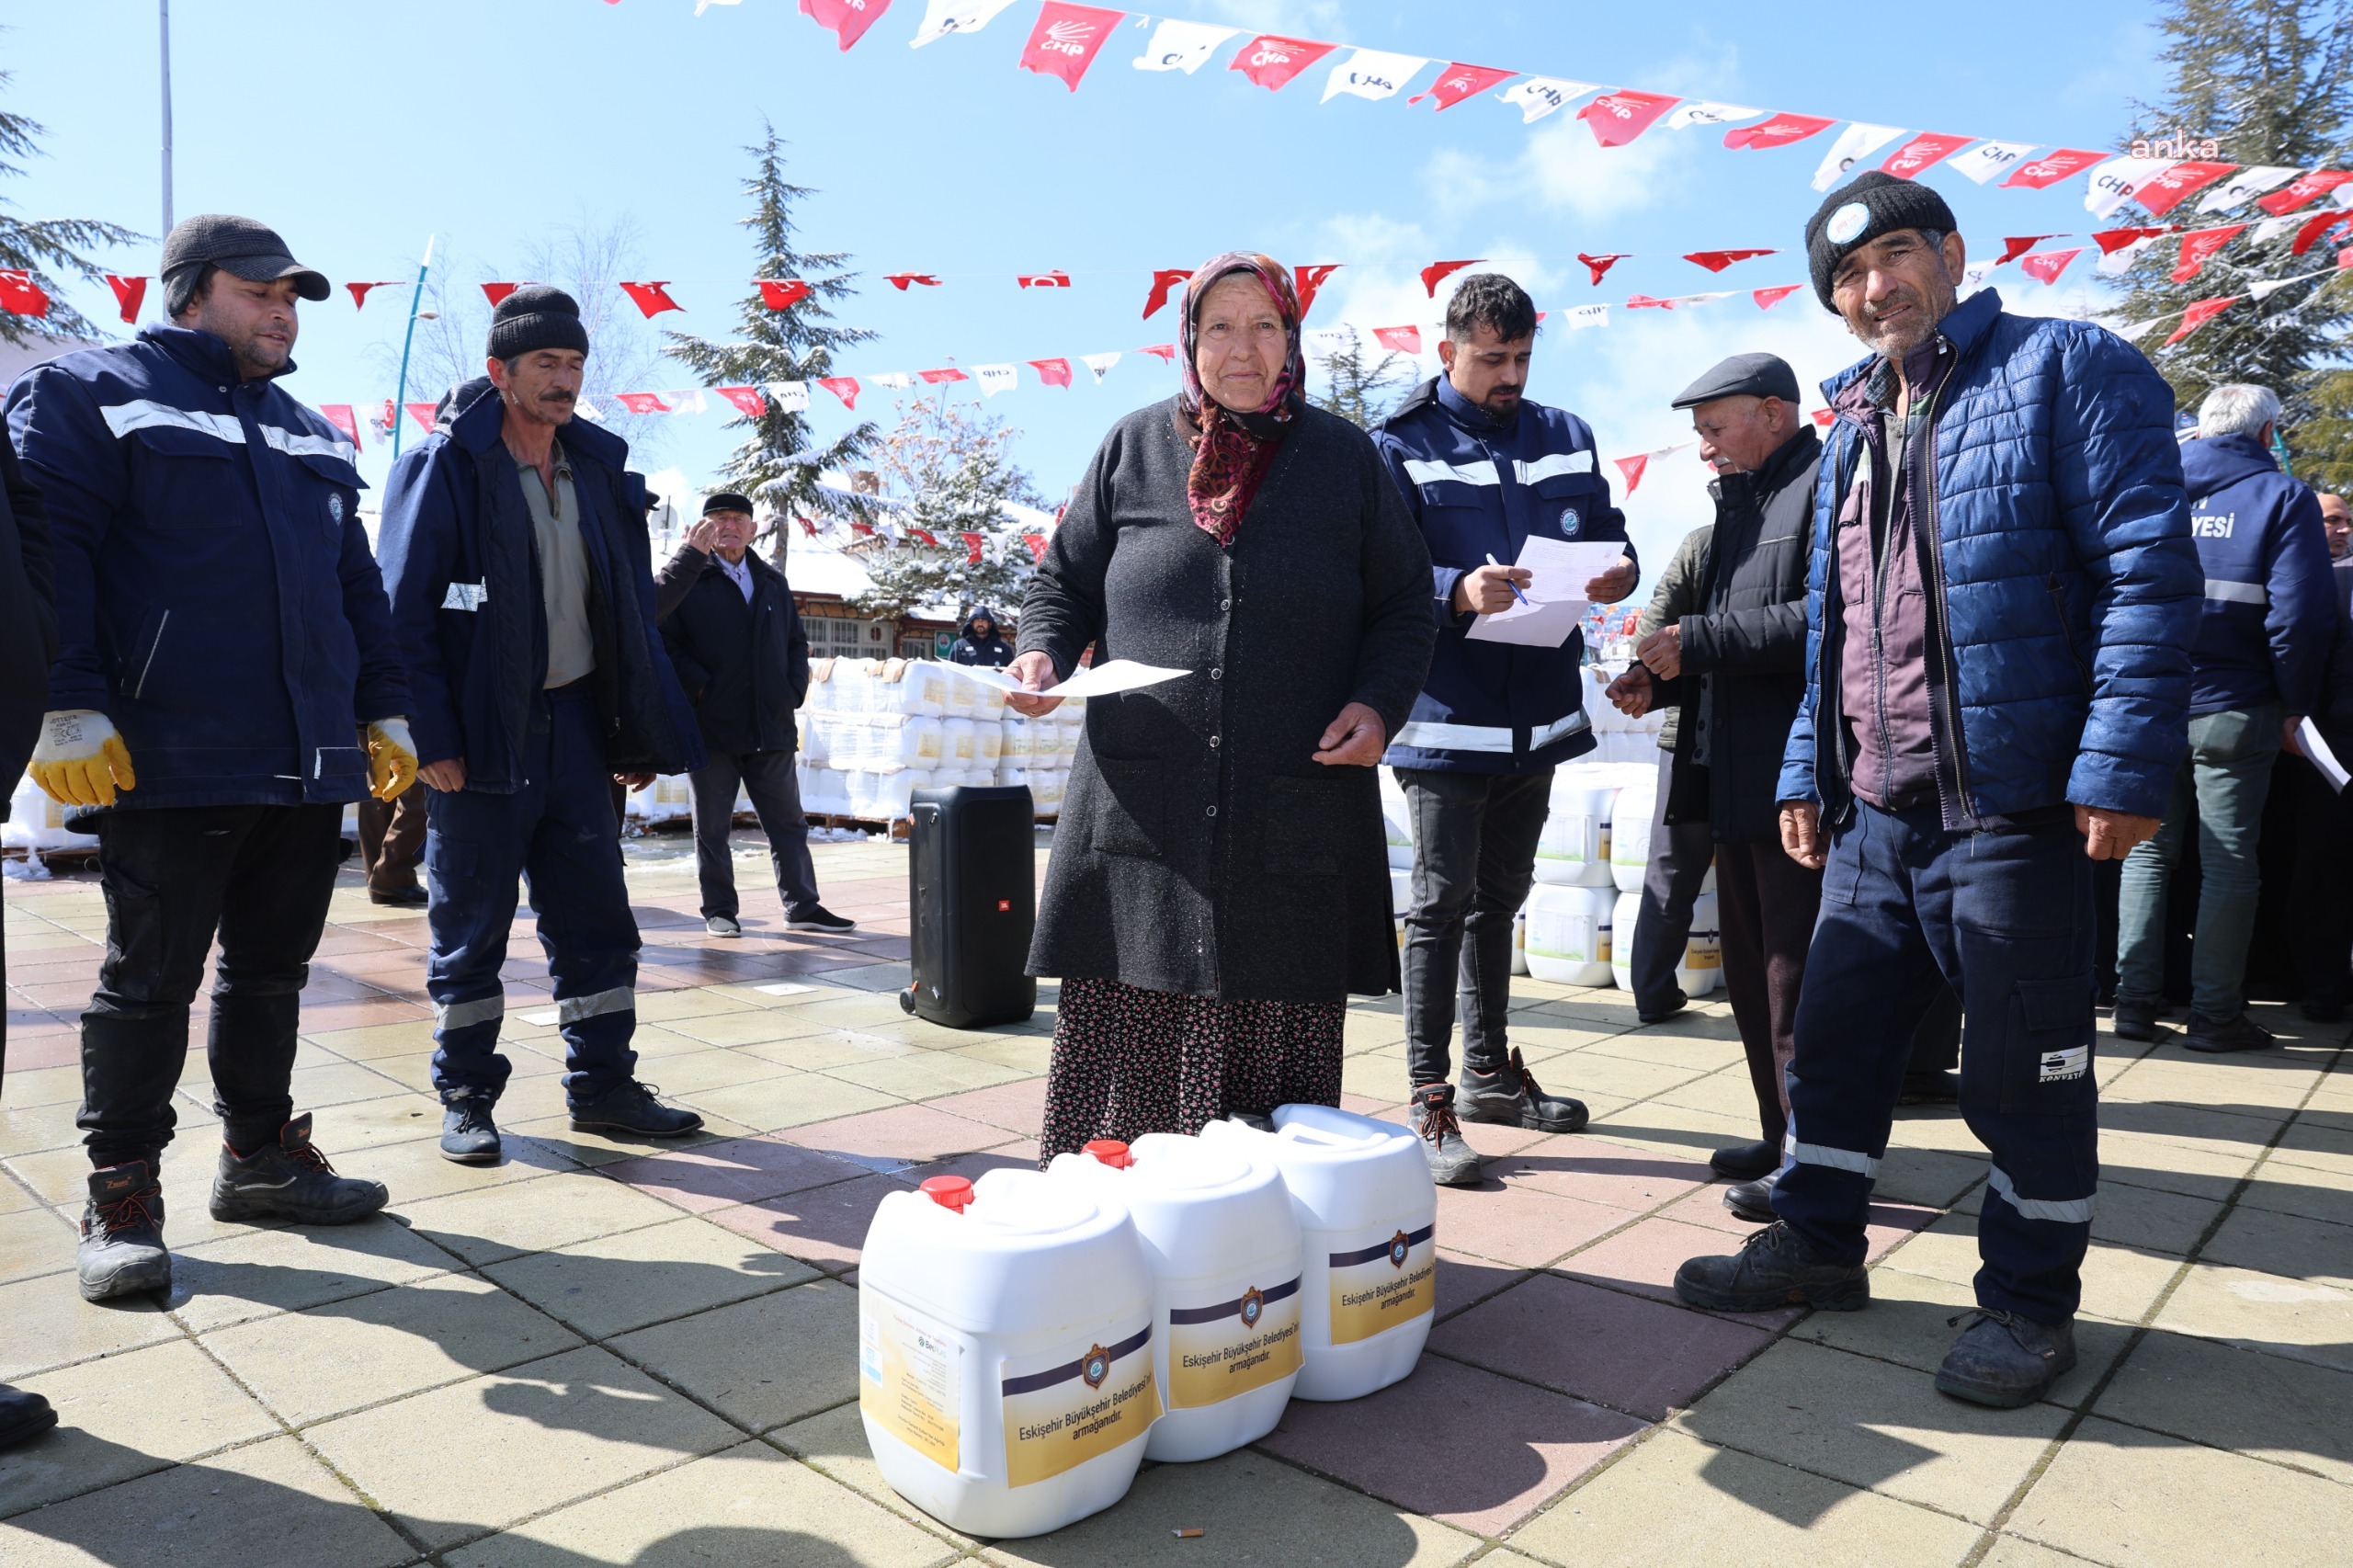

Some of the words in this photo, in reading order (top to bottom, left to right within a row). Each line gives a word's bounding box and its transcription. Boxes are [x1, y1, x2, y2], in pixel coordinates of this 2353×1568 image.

[1040, 40, 1085, 56] CHP
[1250, 51, 1290, 66] CHP
[1527, 85, 1562, 107] CHP
[1596, 98, 1632, 119] CHP
[2097, 175, 2135, 198] CHP
[2190, 512, 2235, 539] YESİ
[1342, 1289, 1376, 1307] Eskişehir
[1376, 1275, 1409, 1298] Büyükşehir
[1381, 1288, 1416, 1310] armağanıdır.
[1183, 1350, 1222, 1369] Eskişehir
[1223, 1336, 1263, 1360] Büyükşehir
[1229, 1349, 1271, 1375] armağanıdır.
[1019, 1416, 1063, 1440] Eskişehir
[1065, 1397, 1111, 1426] Büyükşehir
[1073, 1408, 1123, 1441] armağanıdır.
